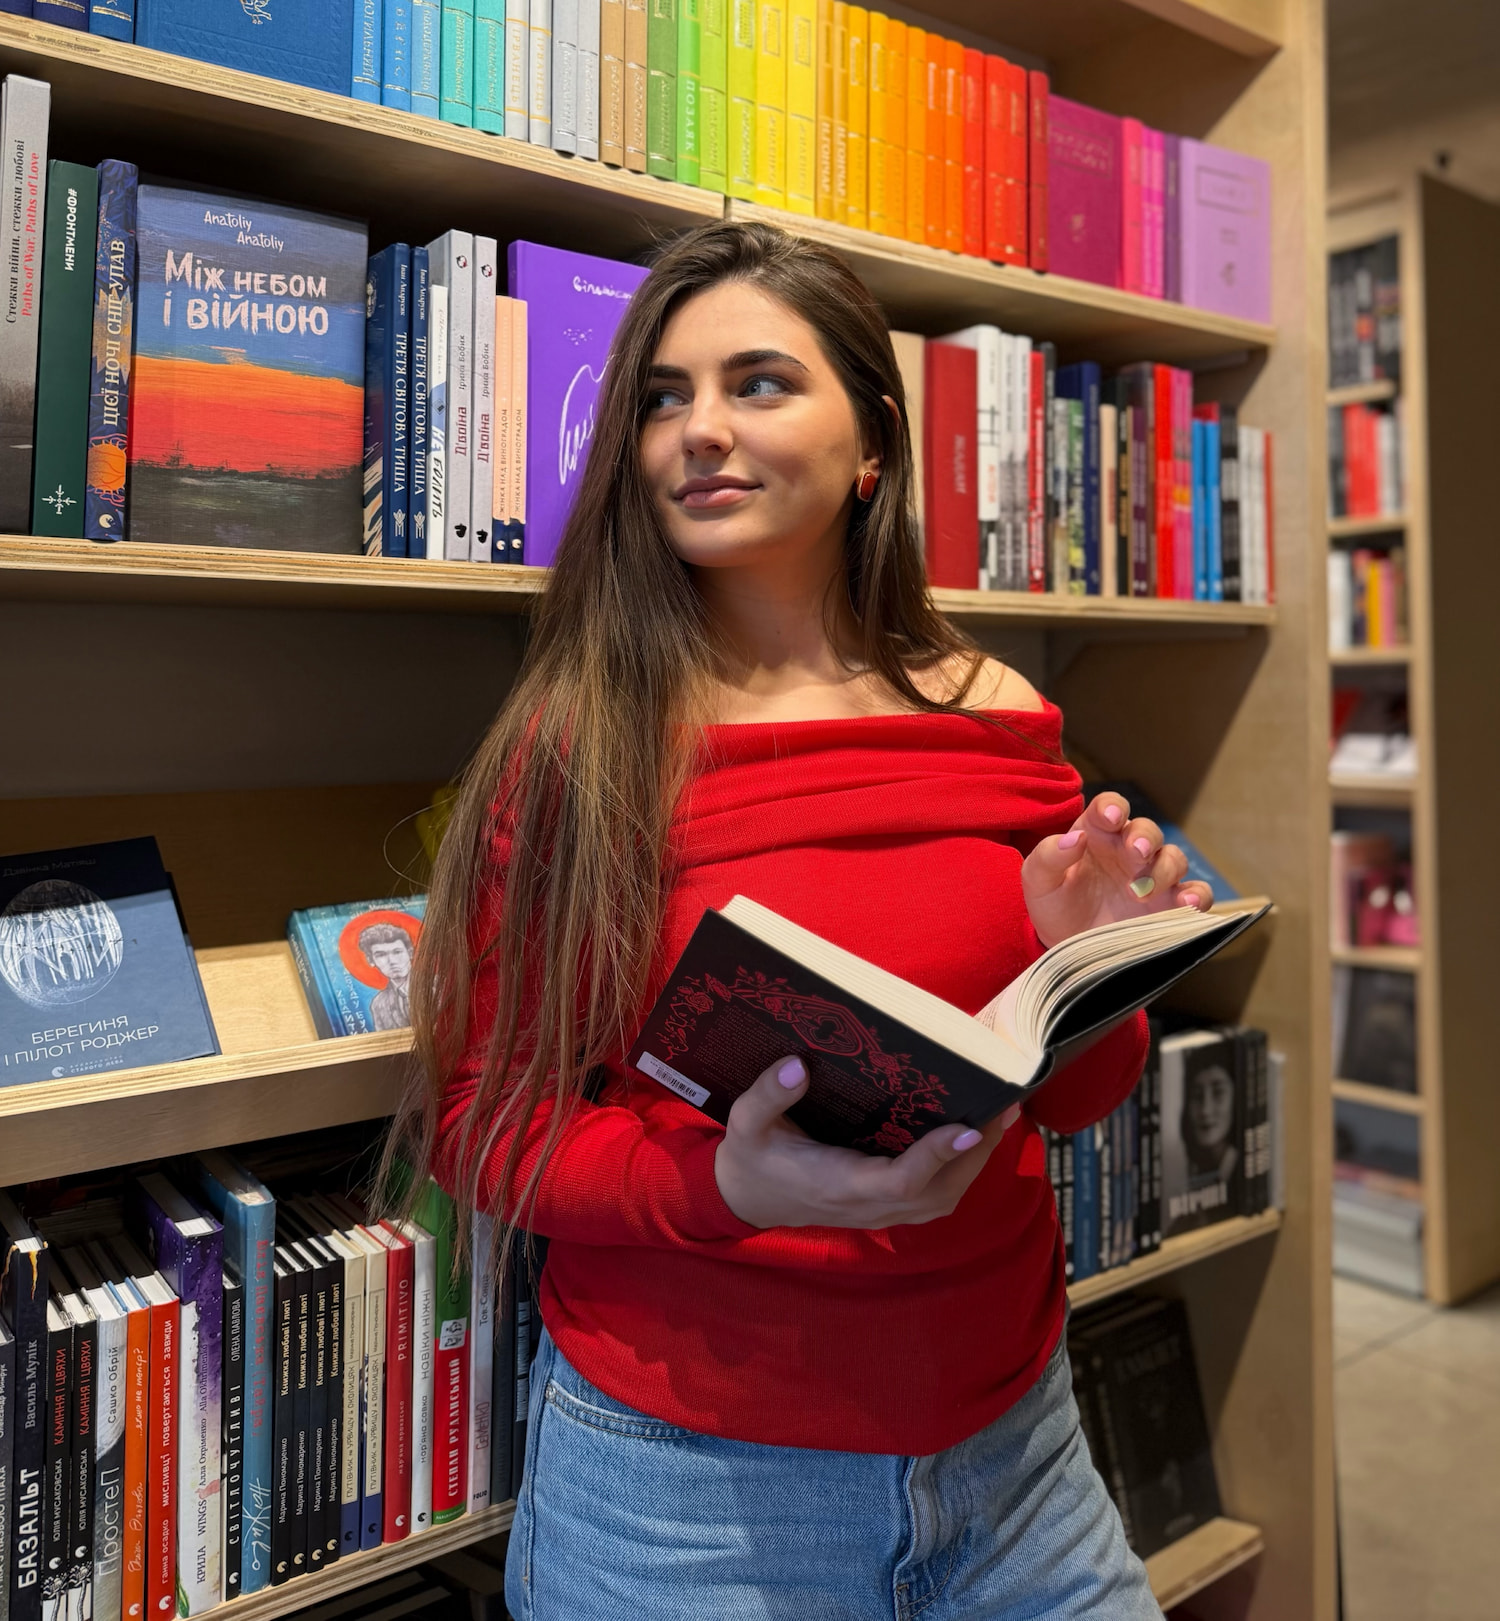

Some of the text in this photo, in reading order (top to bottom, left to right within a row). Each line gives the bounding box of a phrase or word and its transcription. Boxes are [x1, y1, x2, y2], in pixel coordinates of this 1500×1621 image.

[510, 28, 521, 103] ІРВАНЕЦЬ
[535, 37, 545, 111] ІРВАНЕЦЬ
[685, 80, 695, 151] ПОЗАЯК
[5, 140, 25, 323] Стежки війни, стежки любові
[21, 152, 39, 316] Paths of War, Paths of Love
[64, 188, 78, 271] #ФРОНТМЕНИ
[203, 210, 252, 233] Anatoliy
[236, 231, 285, 253] Anatoliy
[164, 249, 226, 293] Між
[399, 264, 407, 279] Іван
[419, 269, 427, 284] Іван
[101, 240, 125, 426] ЦІЄЇ НОЧІ СНІГ УПАВ
[457, 335, 467, 390] Ірина Бобик
[481, 343, 490, 398] Ірина Бобик
[394, 332, 407, 493] ТРЕТЯ СВІТОВА ТИША
[414, 336, 428, 495] ТРЕТЯ СВІТОВА ТИША
[500, 409, 508, 464] ВИНОГРАДОМ
[431, 457, 443, 518] БОЛИТЬ
[499, 467, 507, 484] НАД
[4, 1054, 9, 1066] І
[15, 1042, 75, 1064] ПІЛОТ
[80, 1025, 159, 1052] РОДЖЕР
[31, 1015, 129, 1044] БЕРЕГИНЯ
[282, 1300, 291, 1320] люті
[299, 1294, 308, 1314] люті
[317, 1291, 325, 1312] люті
[331, 1283, 340, 1303] люті
[397, 1279, 409, 1361] PRIMITIVO
[231, 1298, 241, 1362] ОЛЕНА ПАВЛОВА
[281, 1326, 290, 1358] любові
[299, 1321, 307, 1351] любові
[316, 1318, 325, 1349] любові
[330, 1309, 340, 1340] любові
[24, 1340, 40, 1429] Василь Мулік
[55, 1349, 66, 1386] ЦВЯХИ
[80, 1340, 91, 1376] ЦВЯХИ
[107, 1347, 119, 1424] Сашко Обрій
[199, 1345, 209, 1412] Alla Okhrimenko
[281, 1360, 290, 1396] Книжка
[298, 1353, 307, 1389] Книжка
[316, 1350, 324, 1386] Книжка
[330, 1342, 339, 1377] Книжка
[371, 1359, 379, 1401] ОКОЛИЦЯХ
[54, 1396, 65, 1446] КАМІННЯ
[79, 1385, 90, 1435] КАМІННЯ
[135, 1390, 142, 1402] не
[160, 1320, 173, 1507] мисливці повертаються завжди
[199, 1419, 209, 1487] Алла Охріменко
[346, 1366, 355, 1498] ПУТІВНИК УРВИЩУ ОКОЛИЦЯХ
[448, 1358, 460, 1497] СТЕПАН РУДАНСЬКИЙ
[229, 1385, 241, 1545] СВІТЛОЧУТЛИВІ
[279, 1438, 289, 1523] Марина Пономаренко
[295, 1431, 306, 1515] Марина Пономаренко
[313, 1428, 323, 1511] Марина Пономаренко
[328, 1418, 338, 1502] Марина Пономаренко
[370, 1451, 378, 1490] ПУТІВНИК
[53, 1458, 63, 1542] ЮЛІЯ МУСАКОВСЬКА
[78, 1448, 88, 1531] ЮЛІЯ МУСАКОВСЬКА
[473, 1490, 488, 1500] FOLIO
[17, 1469, 40, 1589] БАЗАЛЬТ
[198, 1500, 207, 1536] WINGS
[161, 1519, 170, 1584] ганна осадко
[196, 1546, 206, 1584] КРИЛА
